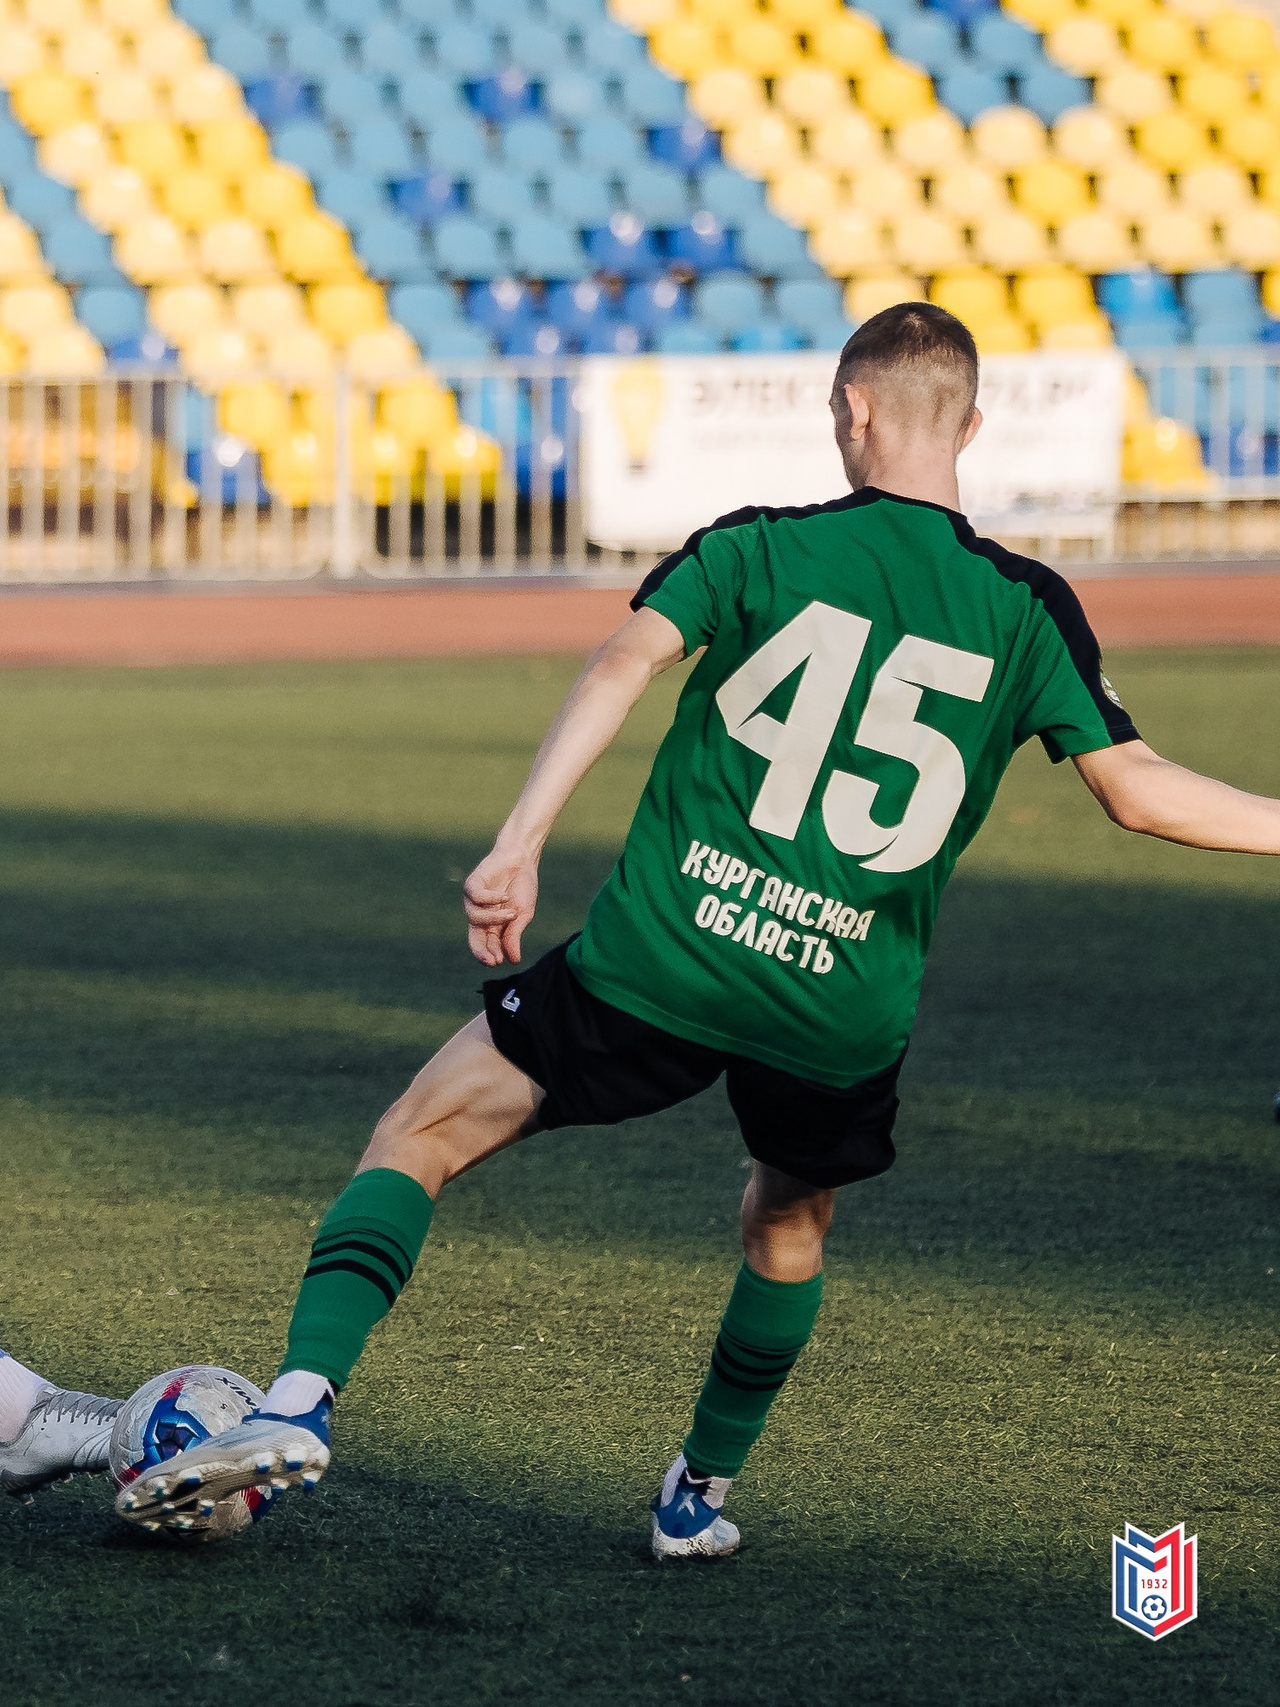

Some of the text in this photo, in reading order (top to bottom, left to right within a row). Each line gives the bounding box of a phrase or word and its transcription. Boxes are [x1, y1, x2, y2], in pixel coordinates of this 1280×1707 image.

[715, 599, 995, 873] 45
[680, 840, 876, 942] КУРГАНСКАЯ
[694, 894, 835, 975] ОБЛАСТЬ
[214, 1376, 259, 1409] MIX
